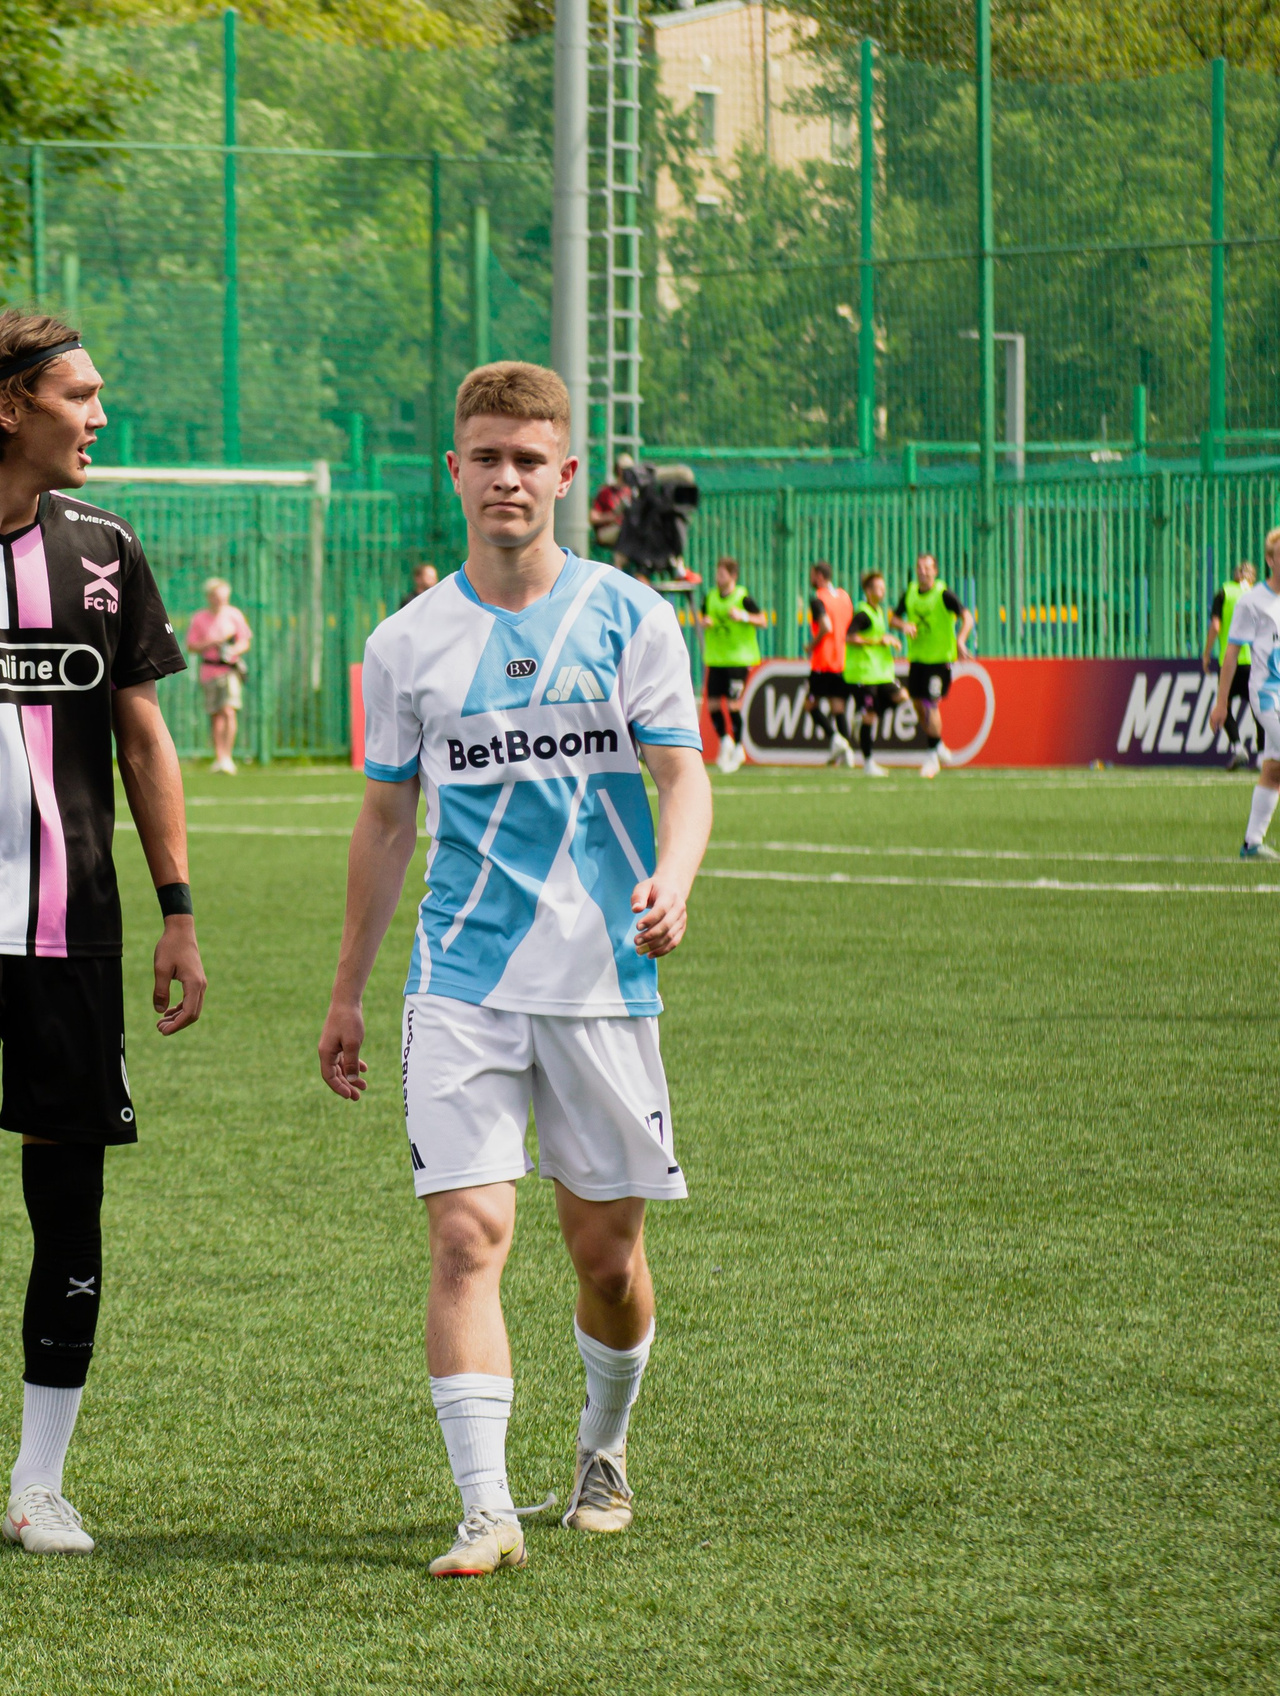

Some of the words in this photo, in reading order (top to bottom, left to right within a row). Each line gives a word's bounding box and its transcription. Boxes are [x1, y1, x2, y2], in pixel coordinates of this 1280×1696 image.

[80, 514, 132, 543] МЕГАФОН
[84, 597, 105, 610] FC
[107, 599, 118, 614] 10
[447, 729, 618, 772] BetBoom
